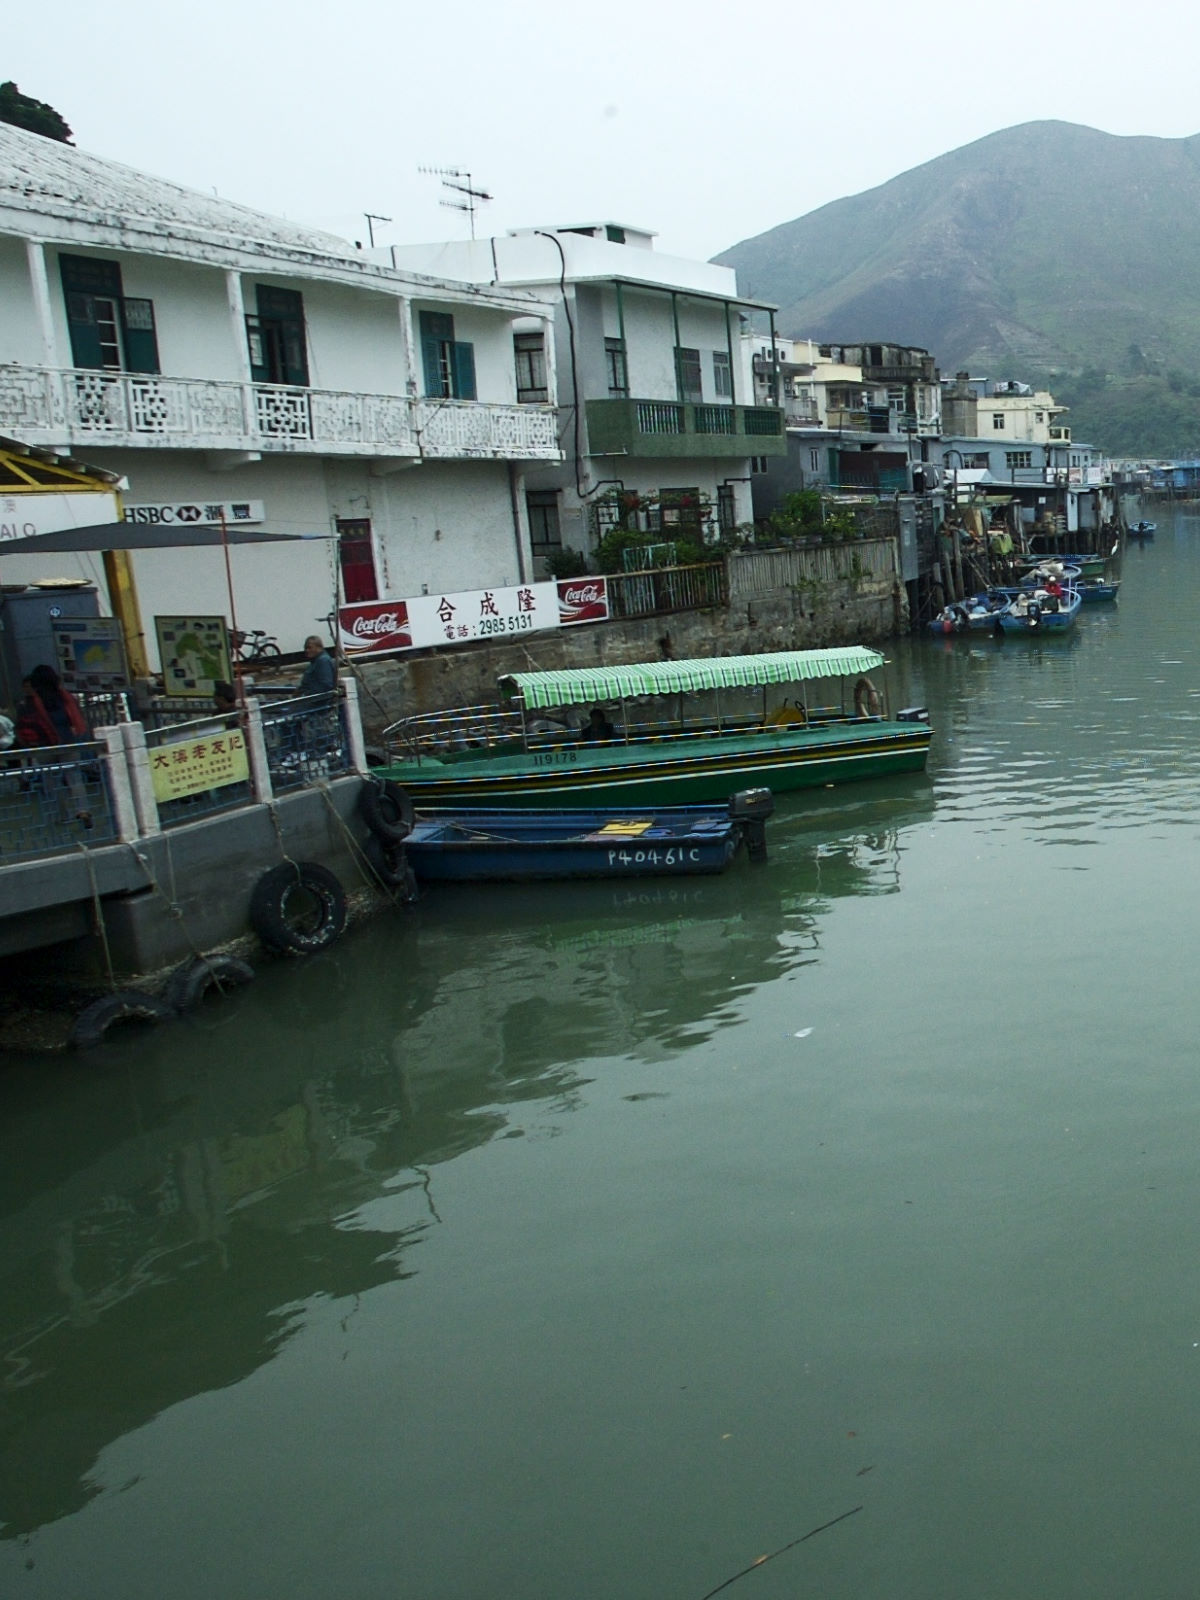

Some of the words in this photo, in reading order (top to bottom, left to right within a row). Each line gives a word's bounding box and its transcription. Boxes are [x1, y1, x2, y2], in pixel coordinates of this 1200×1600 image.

[123, 506, 175, 524] HSBC
[436, 588, 537, 623] 合成隆
[479, 619, 506, 636] 2985
[508, 614, 533, 632] 5131
[534, 752, 577, 766] 119178
[608, 848, 700, 866] P40461C
